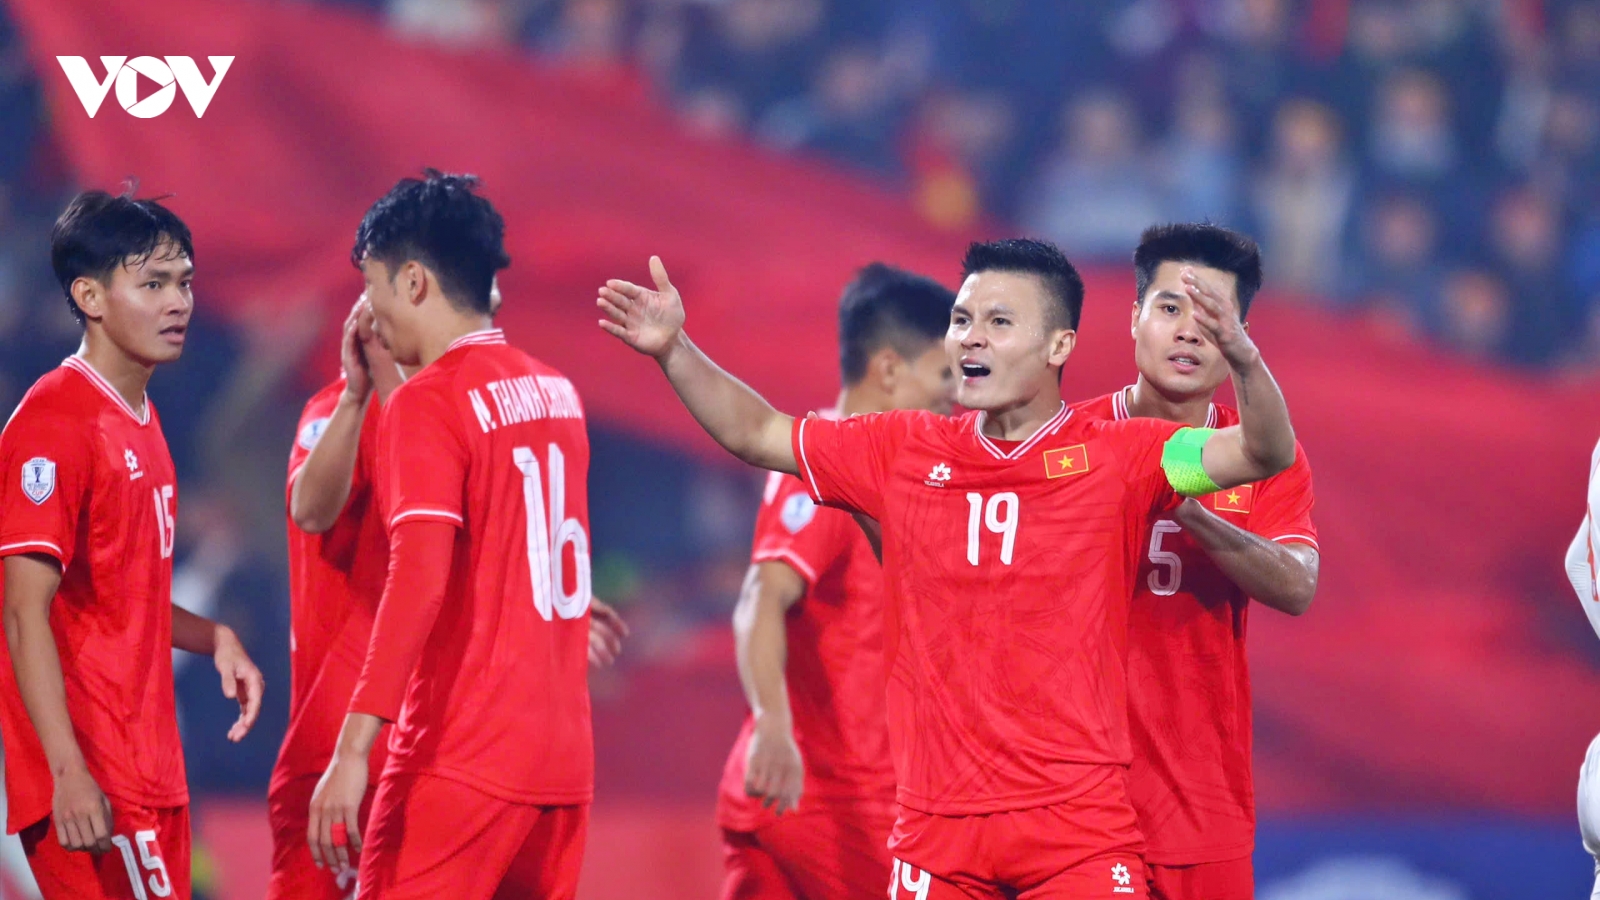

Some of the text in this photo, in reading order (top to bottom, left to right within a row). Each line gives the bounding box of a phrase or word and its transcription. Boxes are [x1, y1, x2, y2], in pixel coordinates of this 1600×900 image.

[468, 388, 497, 433] N.
[486, 375, 547, 426] THANH
[153, 485, 175, 559] 15
[512, 443, 591, 621] 16
[966, 491, 1019, 566] 19
[1147, 520, 1182, 596] 5
[111, 829, 171, 900] 15
